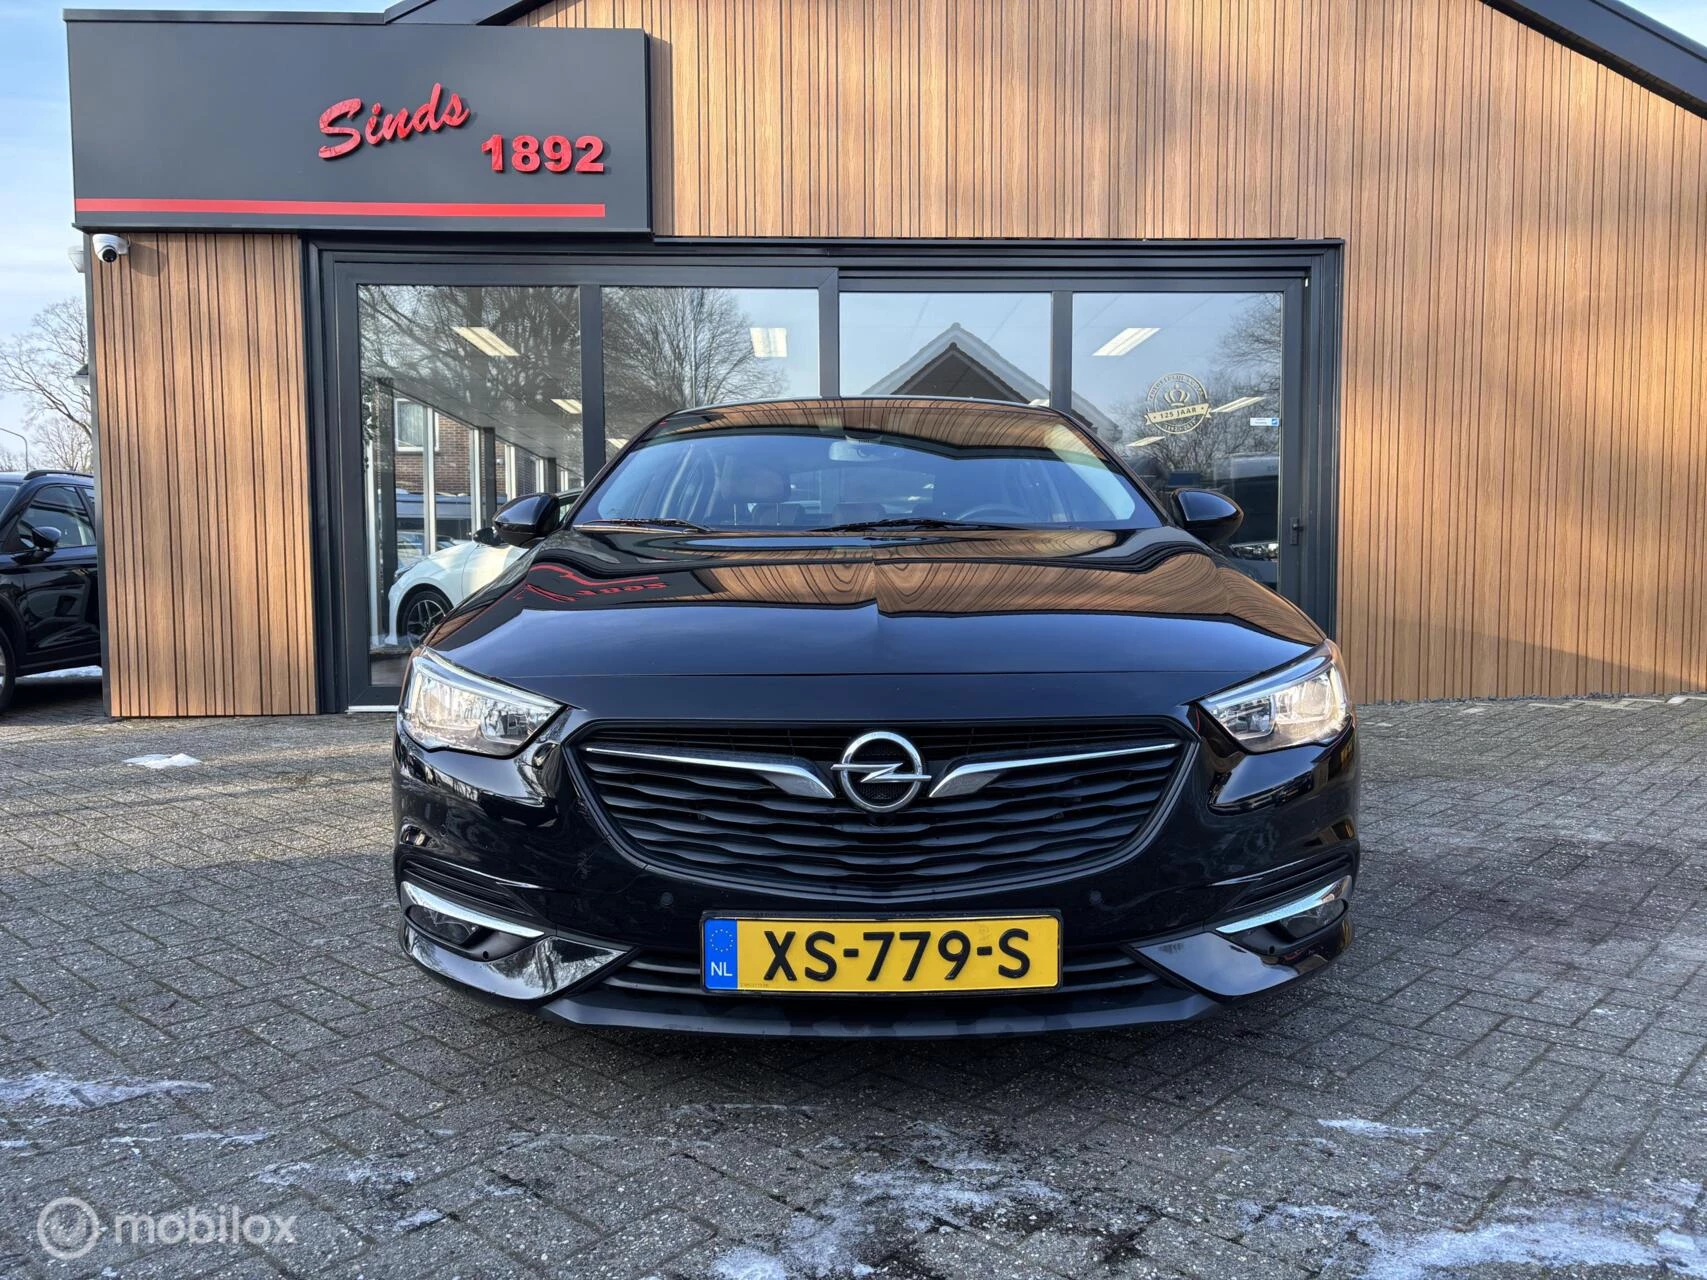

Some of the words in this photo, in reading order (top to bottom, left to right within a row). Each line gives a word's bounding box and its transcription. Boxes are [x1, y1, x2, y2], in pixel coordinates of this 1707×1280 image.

[318, 82, 471, 159] Sinds
[481, 134, 604, 172] 1892
[1177, 407, 1197, 416] JAAR
[710, 961, 733, 977] NL
[763, 928, 1031, 982] XS-779-S
